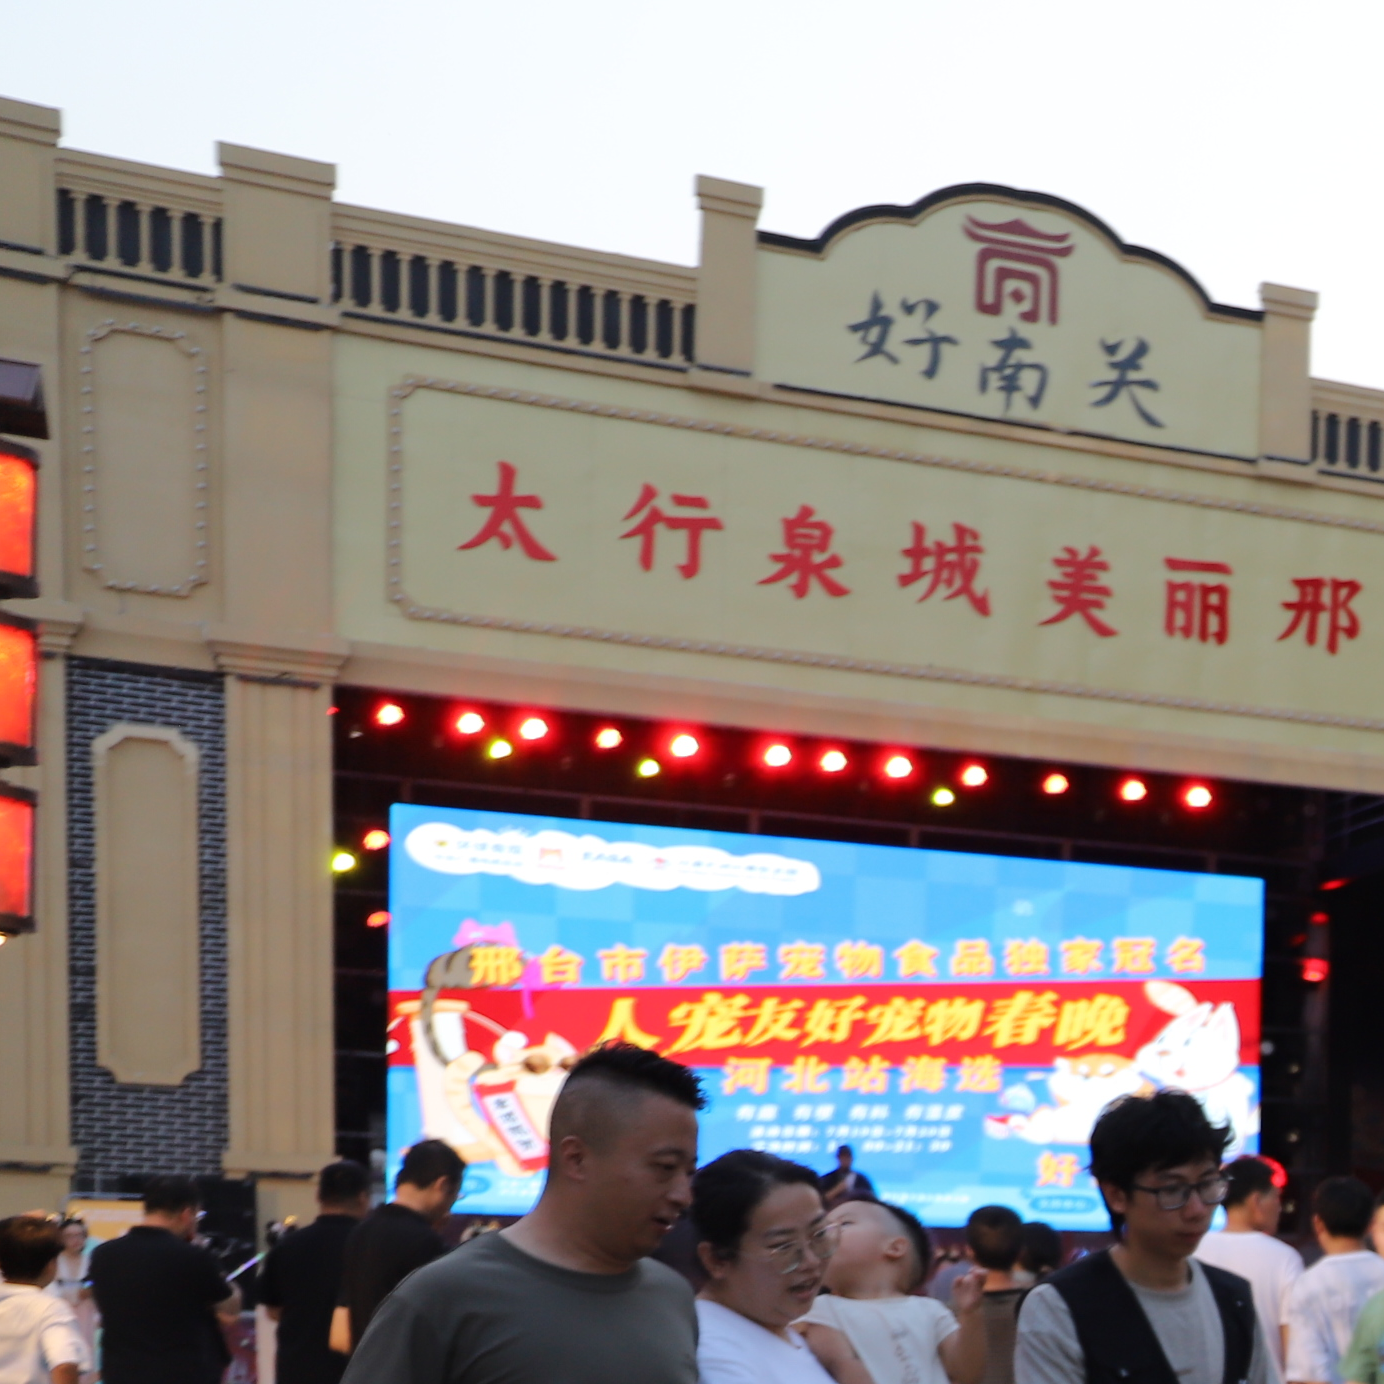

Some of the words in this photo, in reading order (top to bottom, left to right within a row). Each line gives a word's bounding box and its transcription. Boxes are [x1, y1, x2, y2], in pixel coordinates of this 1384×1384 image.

[845, 288, 1168, 430] 好南关
[469, 937, 1207, 987] 邢台市伊萨宠物食品独家冠名
[590, 990, 1131, 1059] 人宠友好宠物春晚
[722, 1055, 1003, 1095] 河北站海选
